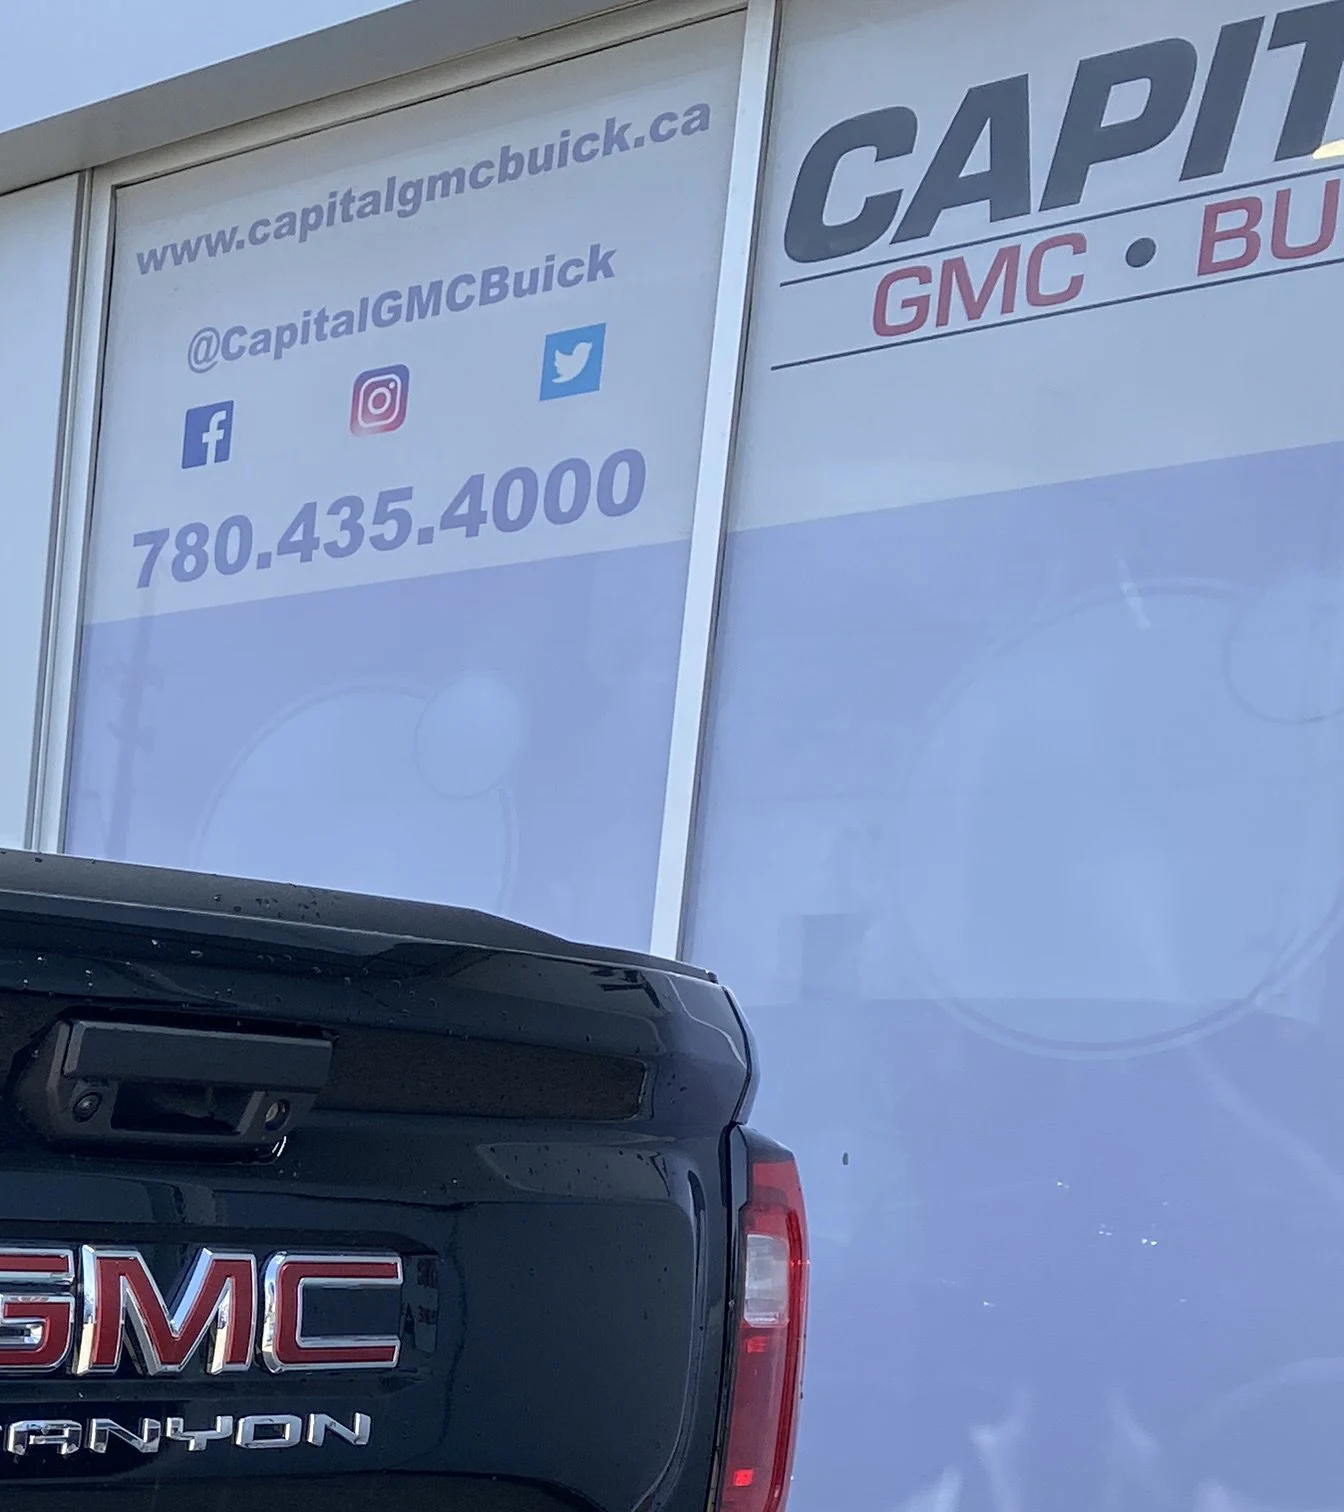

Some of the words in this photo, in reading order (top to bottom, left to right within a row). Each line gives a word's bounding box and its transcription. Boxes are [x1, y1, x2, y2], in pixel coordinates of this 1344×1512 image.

[135, 102, 712, 275] www.capitalgmcbuick.ca
[783, 0, 1344, 265] CAPIT
[187, 242, 618, 374] @CapitalGMCBuick
[872, 232, 1087, 337] GMC
[1196, 178, 1342, 277] BU
[132, 447, 648, 590] 780.435.4000
